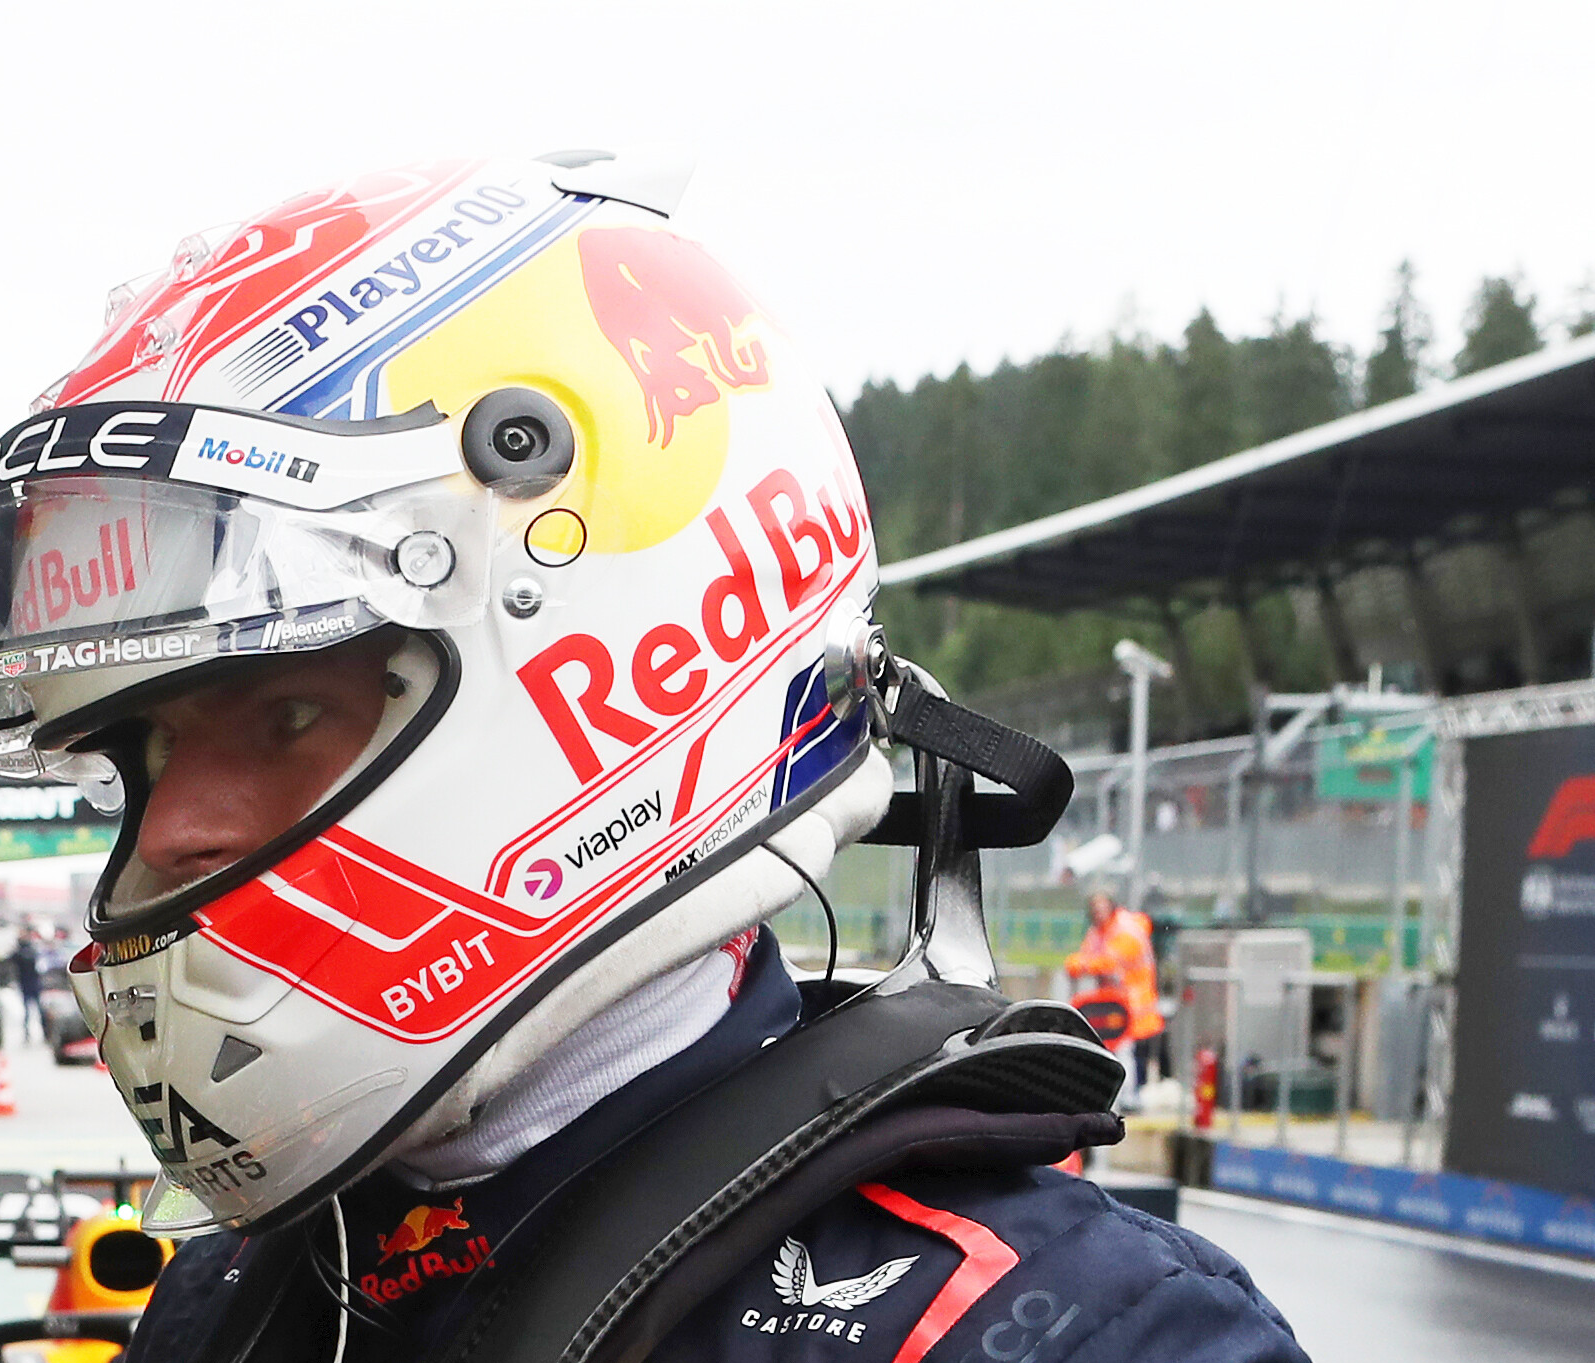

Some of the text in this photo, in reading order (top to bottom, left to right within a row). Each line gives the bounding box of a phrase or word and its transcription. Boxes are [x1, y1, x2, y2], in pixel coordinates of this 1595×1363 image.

[197, 437, 284, 475] Mobil
[281, 615, 355, 640] Blenders
[516, 507, 770, 785] Red
[565, 790, 663, 869] viaplay
[380, 931, 496, 1021] BYBIT
[360, 1236, 495, 1307] Red Bull
[741, 1309, 867, 1343] CASTORE
